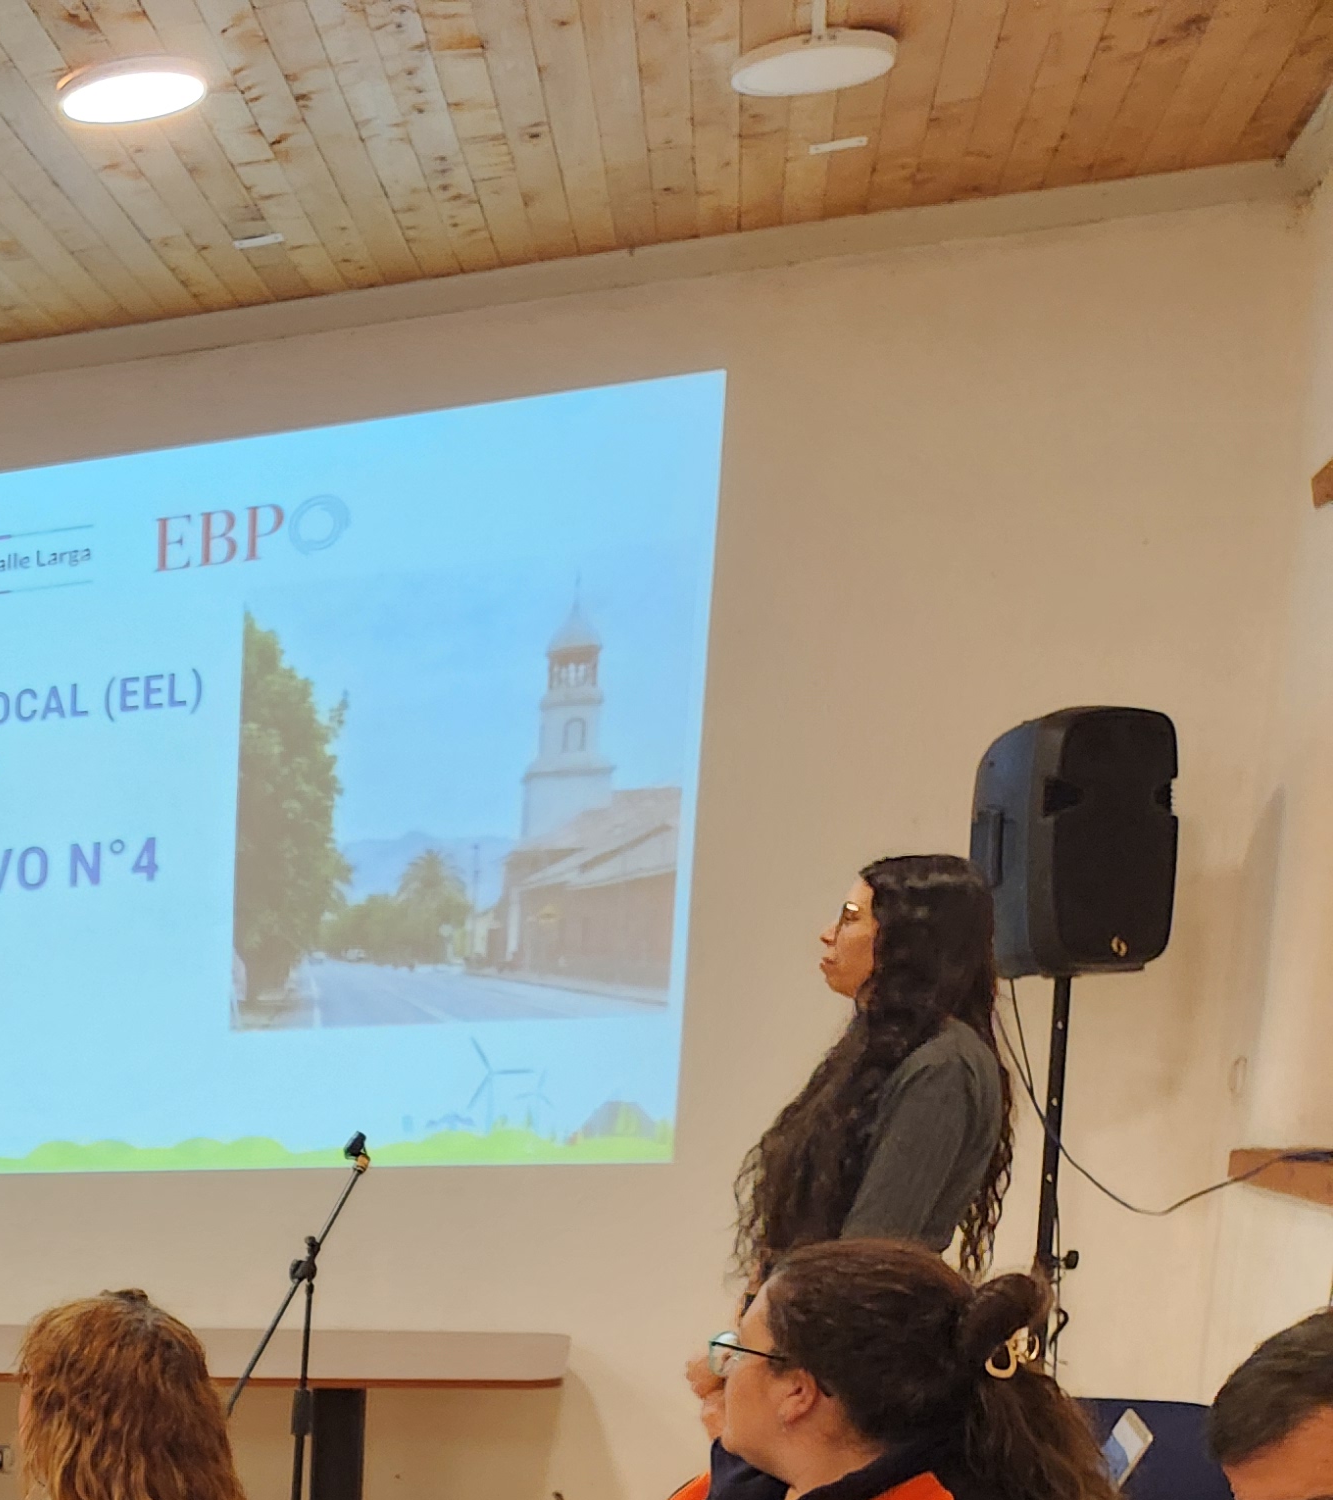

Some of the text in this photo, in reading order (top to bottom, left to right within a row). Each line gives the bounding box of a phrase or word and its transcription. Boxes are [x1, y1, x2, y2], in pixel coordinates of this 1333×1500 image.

[36, 545, 93, 568] Larga
[153, 503, 284, 573] EBP
[103, 668, 203, 722] (EEL)
[68, 836, 160, 888] N°4
